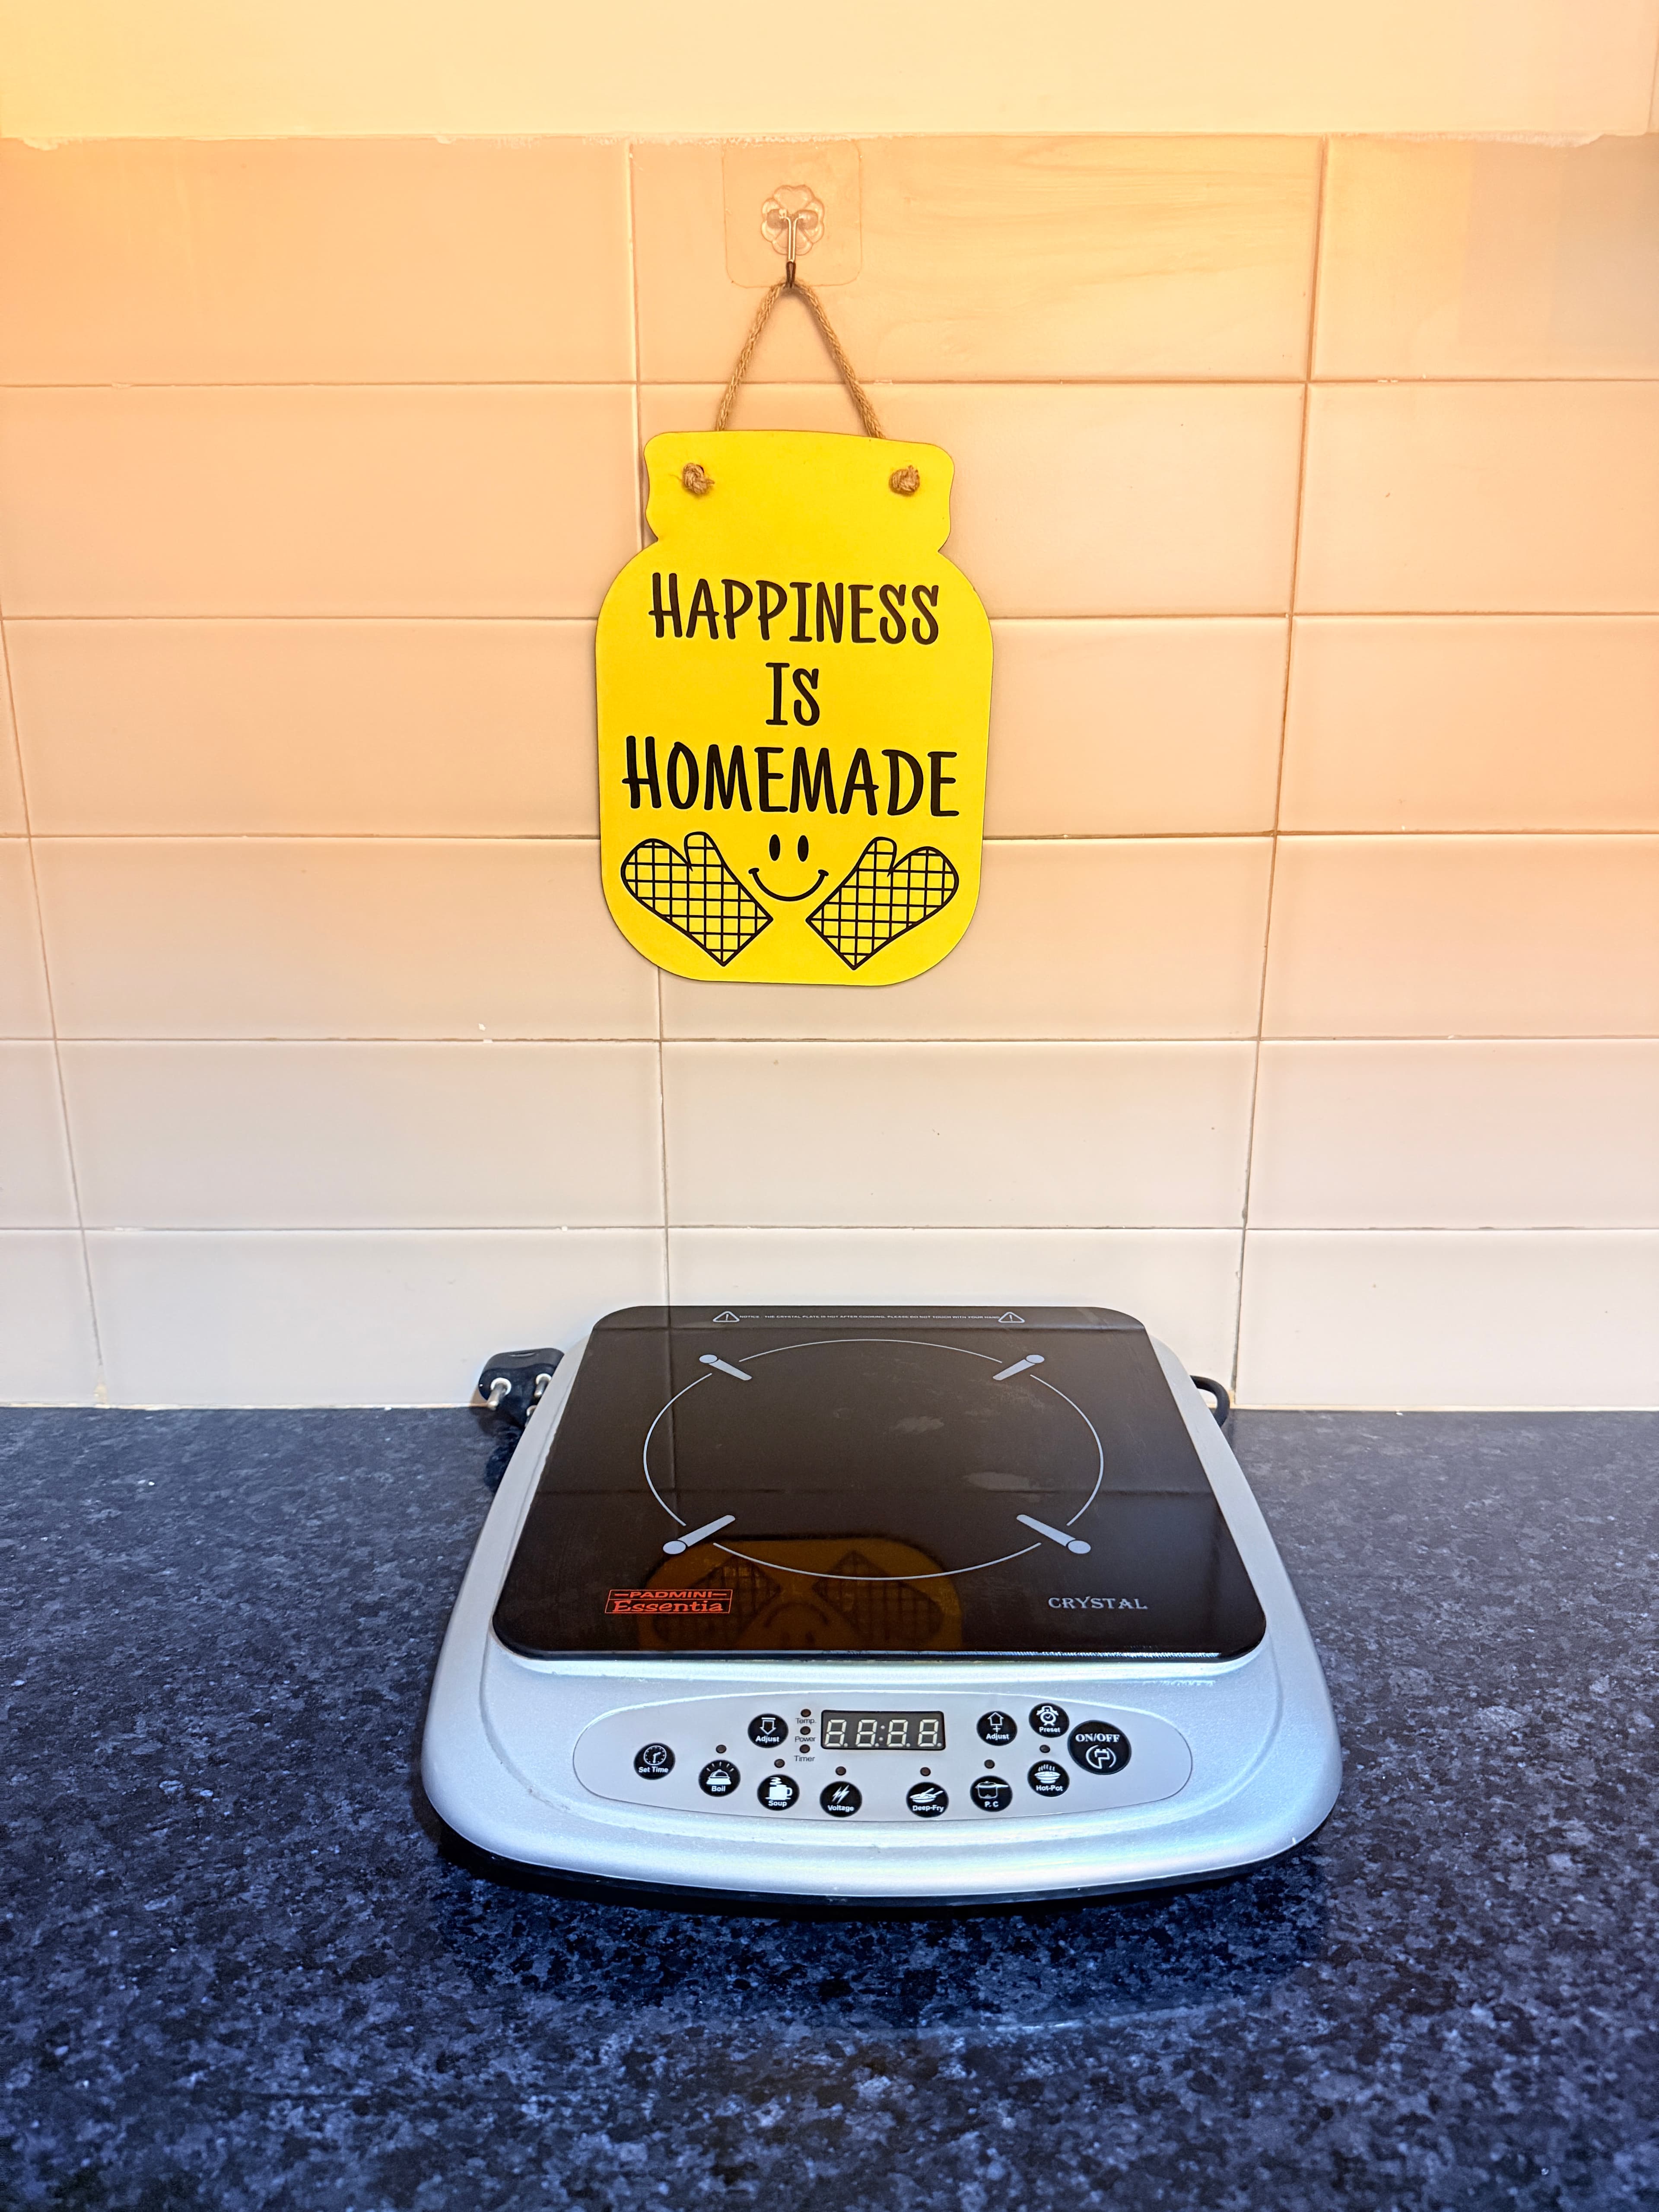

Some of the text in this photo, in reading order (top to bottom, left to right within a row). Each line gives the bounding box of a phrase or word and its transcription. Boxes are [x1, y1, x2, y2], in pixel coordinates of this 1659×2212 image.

[648, 572, 939, 645] HAPPINESS
[765, 662, 820, 727] IS
[622, 736, 960, 817] HOMEMADE
[612, 1600, 723, 1613] Essentia
[1048, 1596, 1148, 1609] CRYSTAL
[755, 1735, 780, 1744] Adjust
[985, 1732, 1009, 1741] Adjust
[1075, 1733, 1120, 1743] ON/OFF
[827, 1804, 855, 1813] Voltage
[912, 1804, 944, 1813] Deep-Fry
